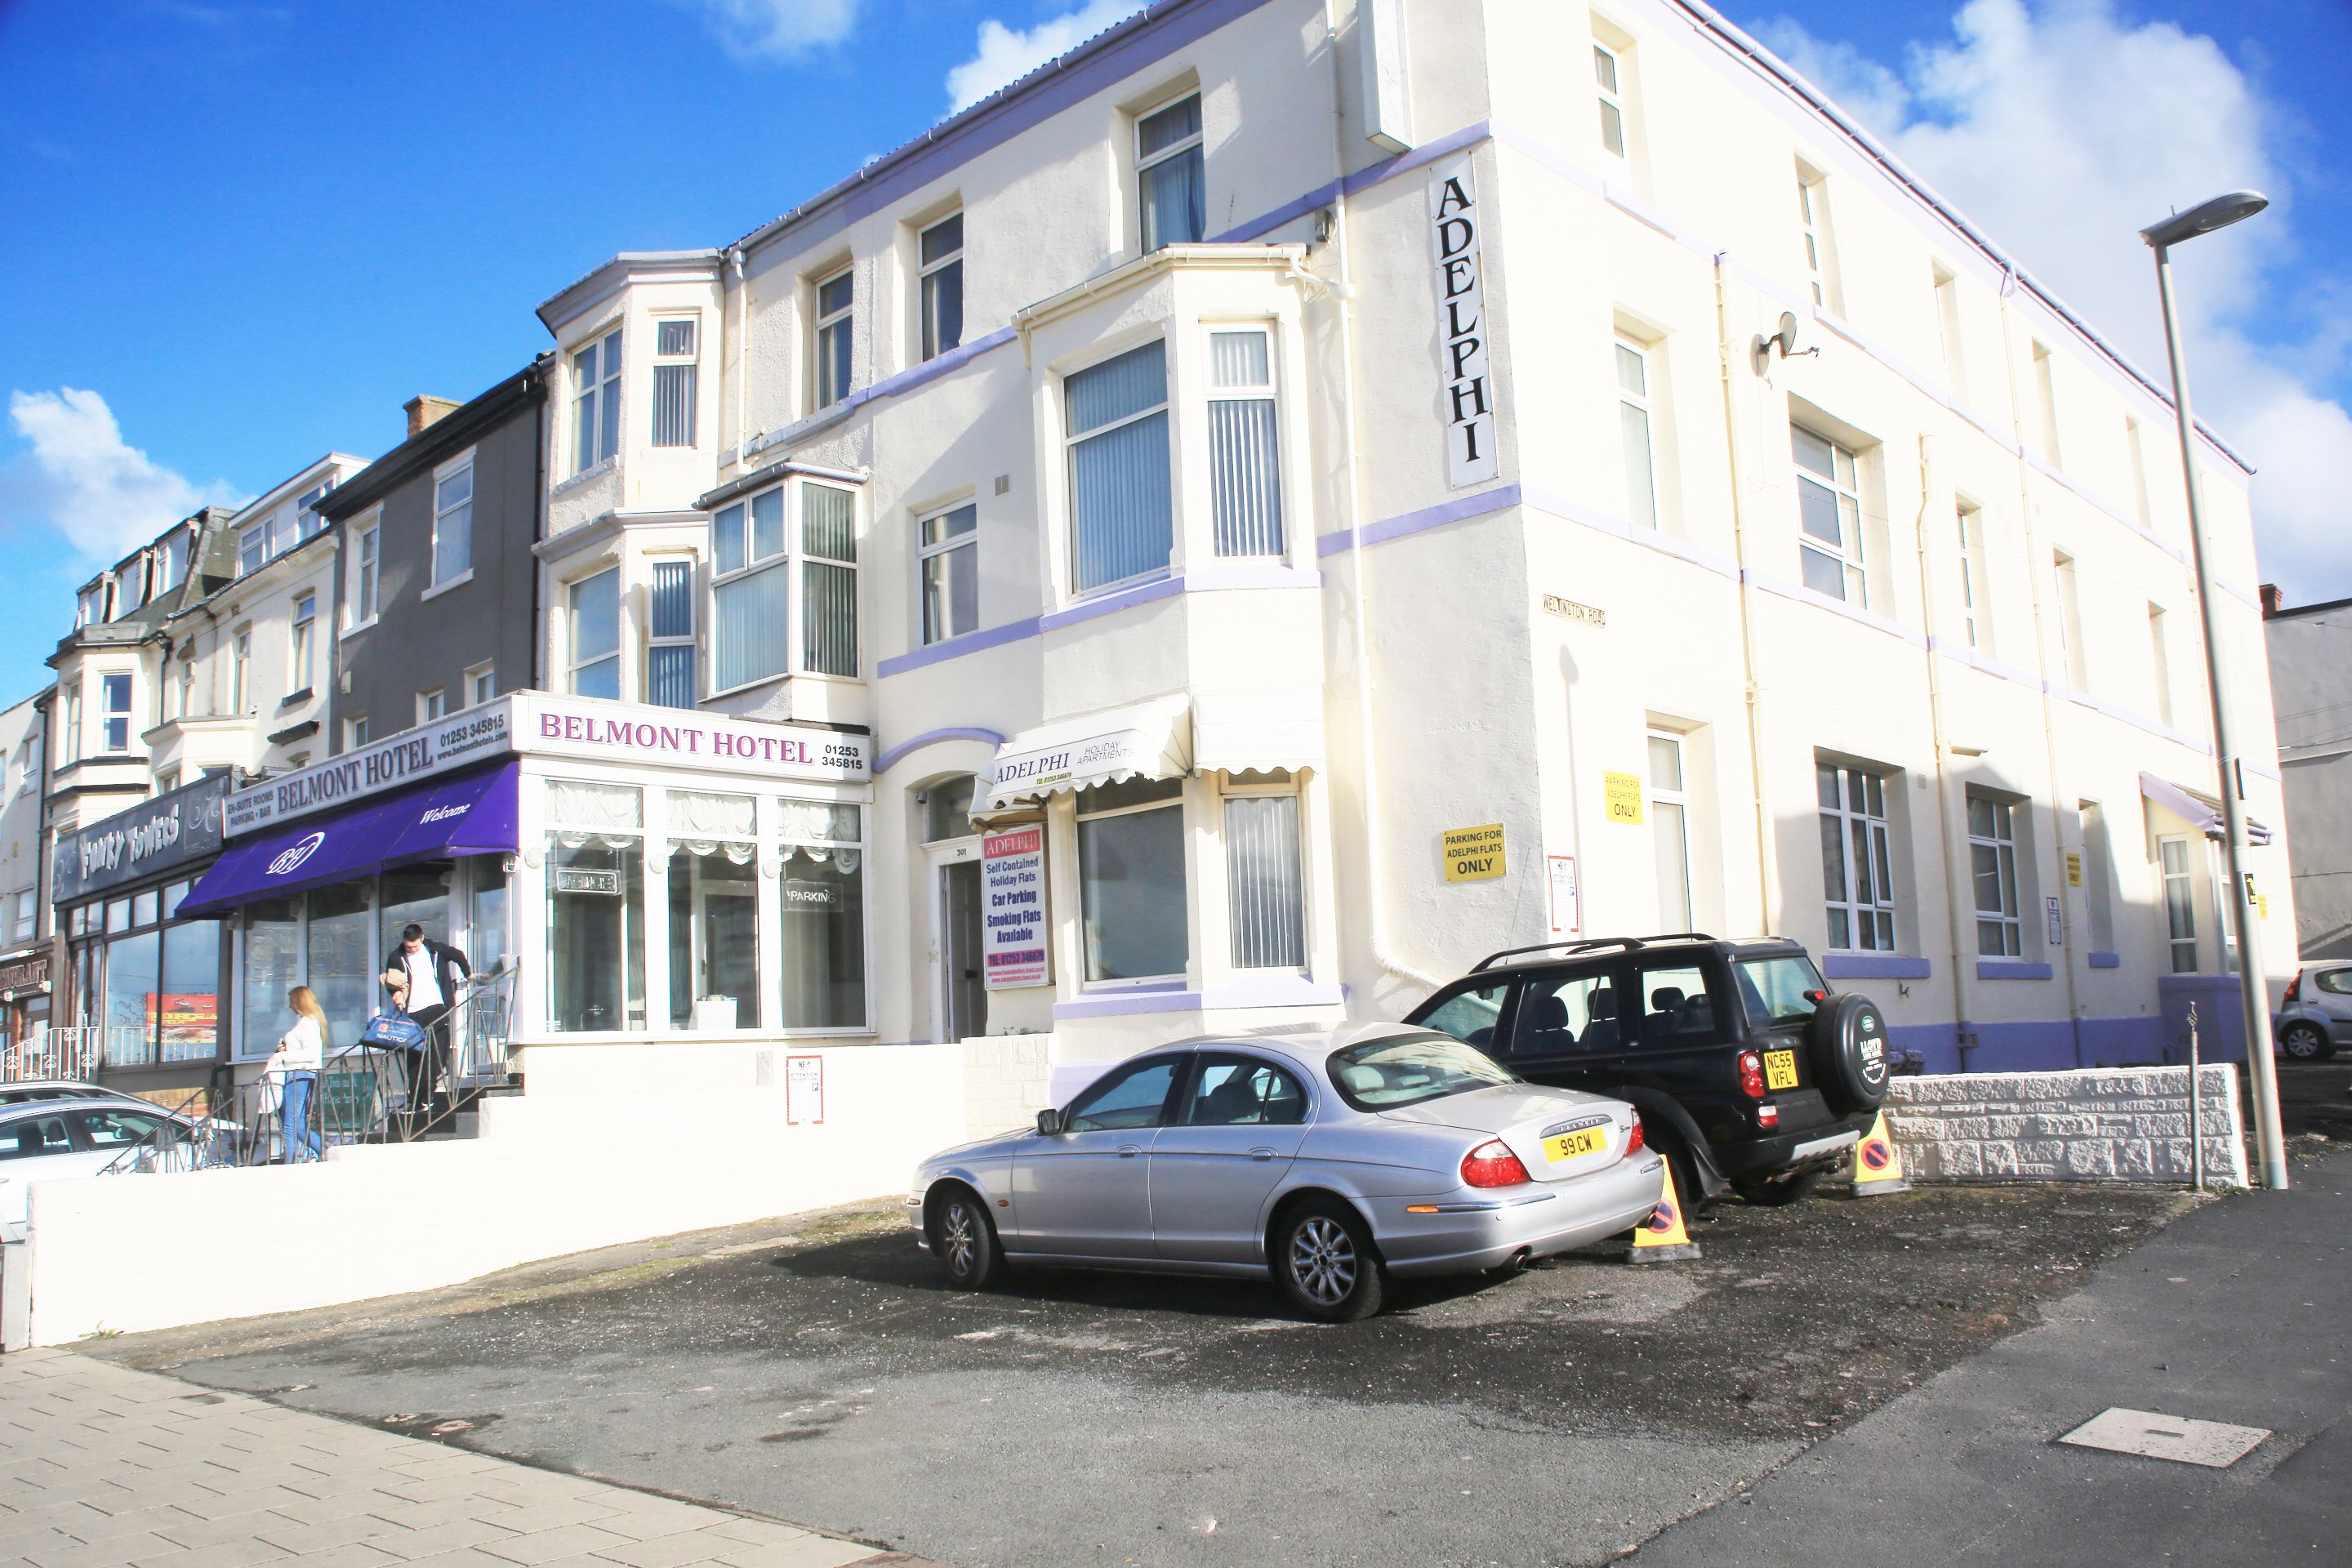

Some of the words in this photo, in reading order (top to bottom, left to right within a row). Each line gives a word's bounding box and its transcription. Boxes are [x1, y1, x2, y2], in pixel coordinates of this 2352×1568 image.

[1436, 176, 1488, 463] ADELPHI
[1543, 595, 1584, 619] WELINGTON
[440, 727, 467, 747] 01253
[470, 714, 504, 737] 345815
[539, 713, 703, 753] BELMONT
[713, 732, 813, 764] HOTEL
[438, 731, 508, 760] www.belmonthotels.com
[825, 744, 859, 757] 01253
[1085, 740, 1121, 755] HOLIDAY
[822, 756, 863, 769] 345815
[1076, 748, 1136, 765] APARTMENTS
[277, 760, 362, 814] BELMONT
[365, 737, 434, 786] HOTEL
[995, 752, 1071, 784] ADELPHI
[227, 797, 252, 814] EN-SUITE
[253, 790, 274, 806] ROOMS
[1615, 804, 1636, 817] ONLY
[230, 811, 255, 827] PARKING
[260, 805, 272, 818] BAR
[420, 803, 471, 825] Welcome
[127, 804, 180, 863] TOWERS
[1446, 832, 1483, 845] PARKING
[1484, 830, 1502, 840] FOR
[956, 848, 967, 857] 301
[987, 834, 1038, 855] ADELPHI
[1447, 846, 1478, 858] ADELPHI
[1480, 843, 1503, 854] FLATS
[987, 862, 1000, 874] Self
[1002, 856, 1039, 871] Contained
[1457, 858, 1493, 875] ONLY
[991, 875, 1017, 888] Holiday
[1018, 872, 1036, 884] Flats
[791, 890, 836, 903] PARKING
[992, 893, 1006, 907] Car
[1007, 889, 1036, 904] Parking
[987, 912, 1022, 928] Smoking
[1022, 910, 1041, 923] Flats
[997, 928, 1033, 943] Available
[1001, 952, 1020, 964] 01253
[1860, 1037, 1882, 1054] LLOYD
[1766, 1053, 1792, 1069] NC55
[1773, 1071, 1793, 1085] VFL
[1560, 1138, 1576, 1156] 99
[1576, 1134, 1592, 1152] CW
